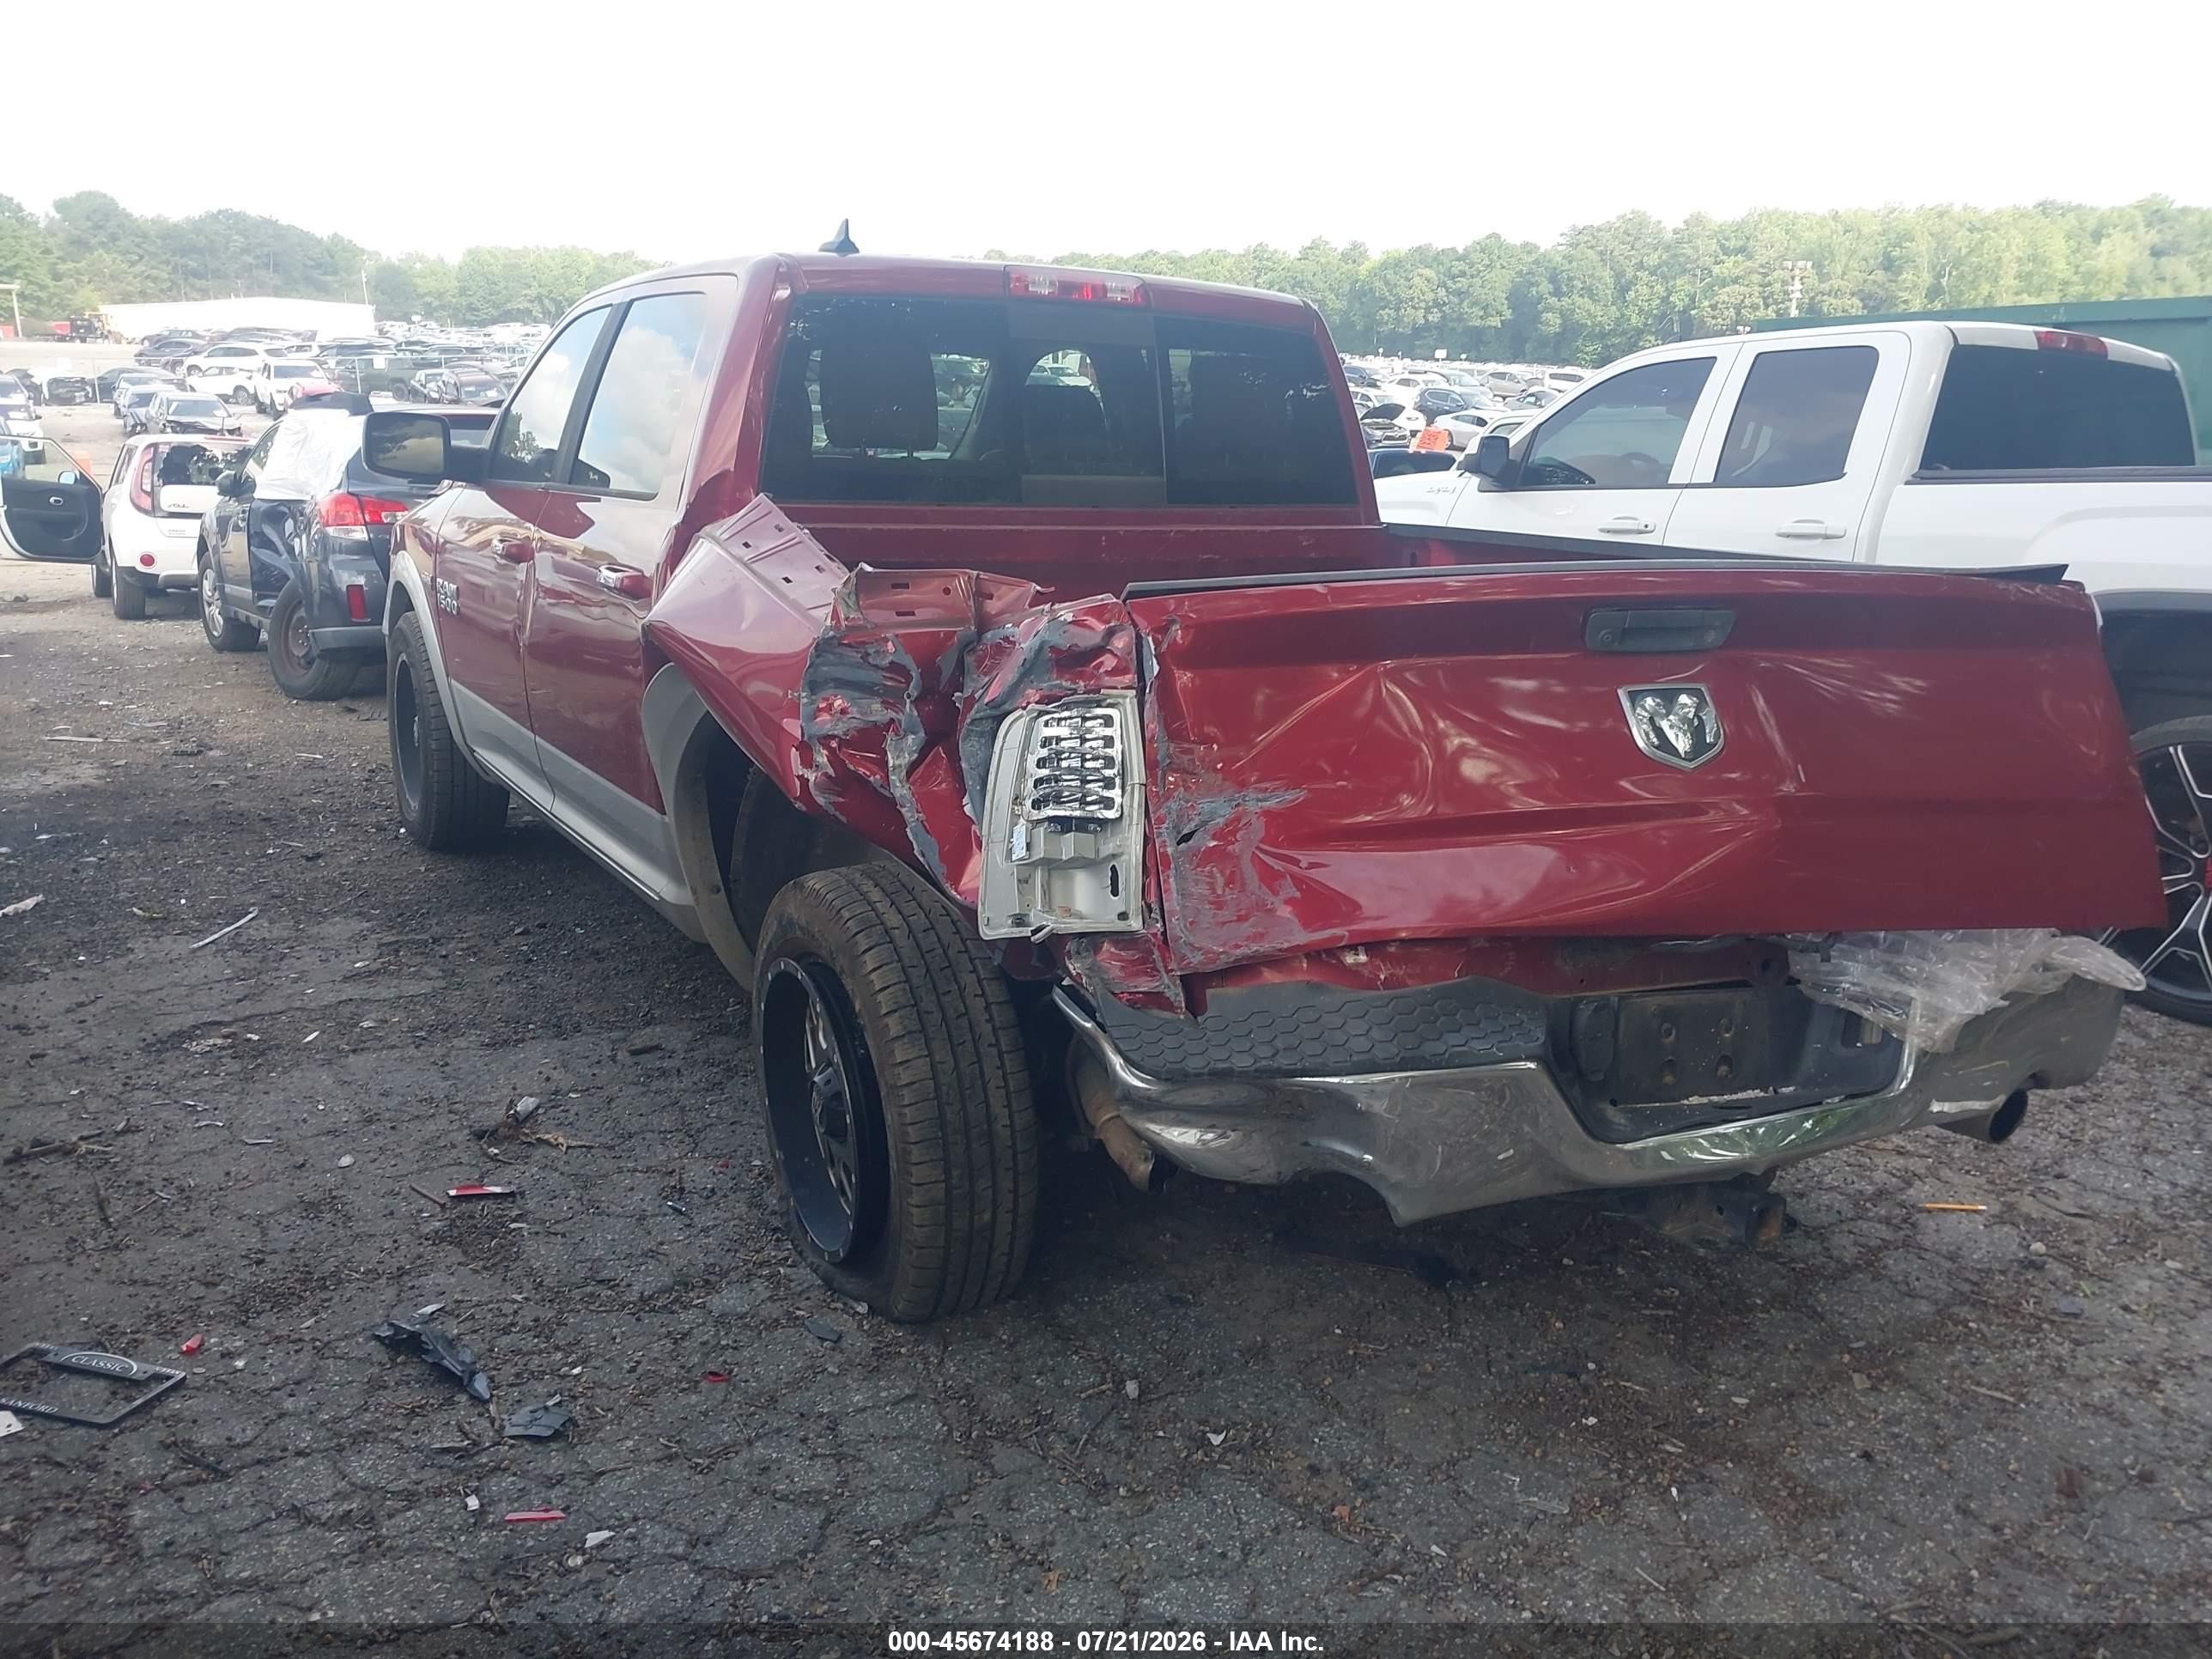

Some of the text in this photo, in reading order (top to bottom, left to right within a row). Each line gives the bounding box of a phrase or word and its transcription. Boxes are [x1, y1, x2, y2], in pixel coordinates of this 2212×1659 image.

[437, 578, 459, 599] RAM
[438, 593, 459, 616] 1500
[71, 1356, 129, 1372] CLASSIC
[0, 1398, 58, 1413] SANFORD
